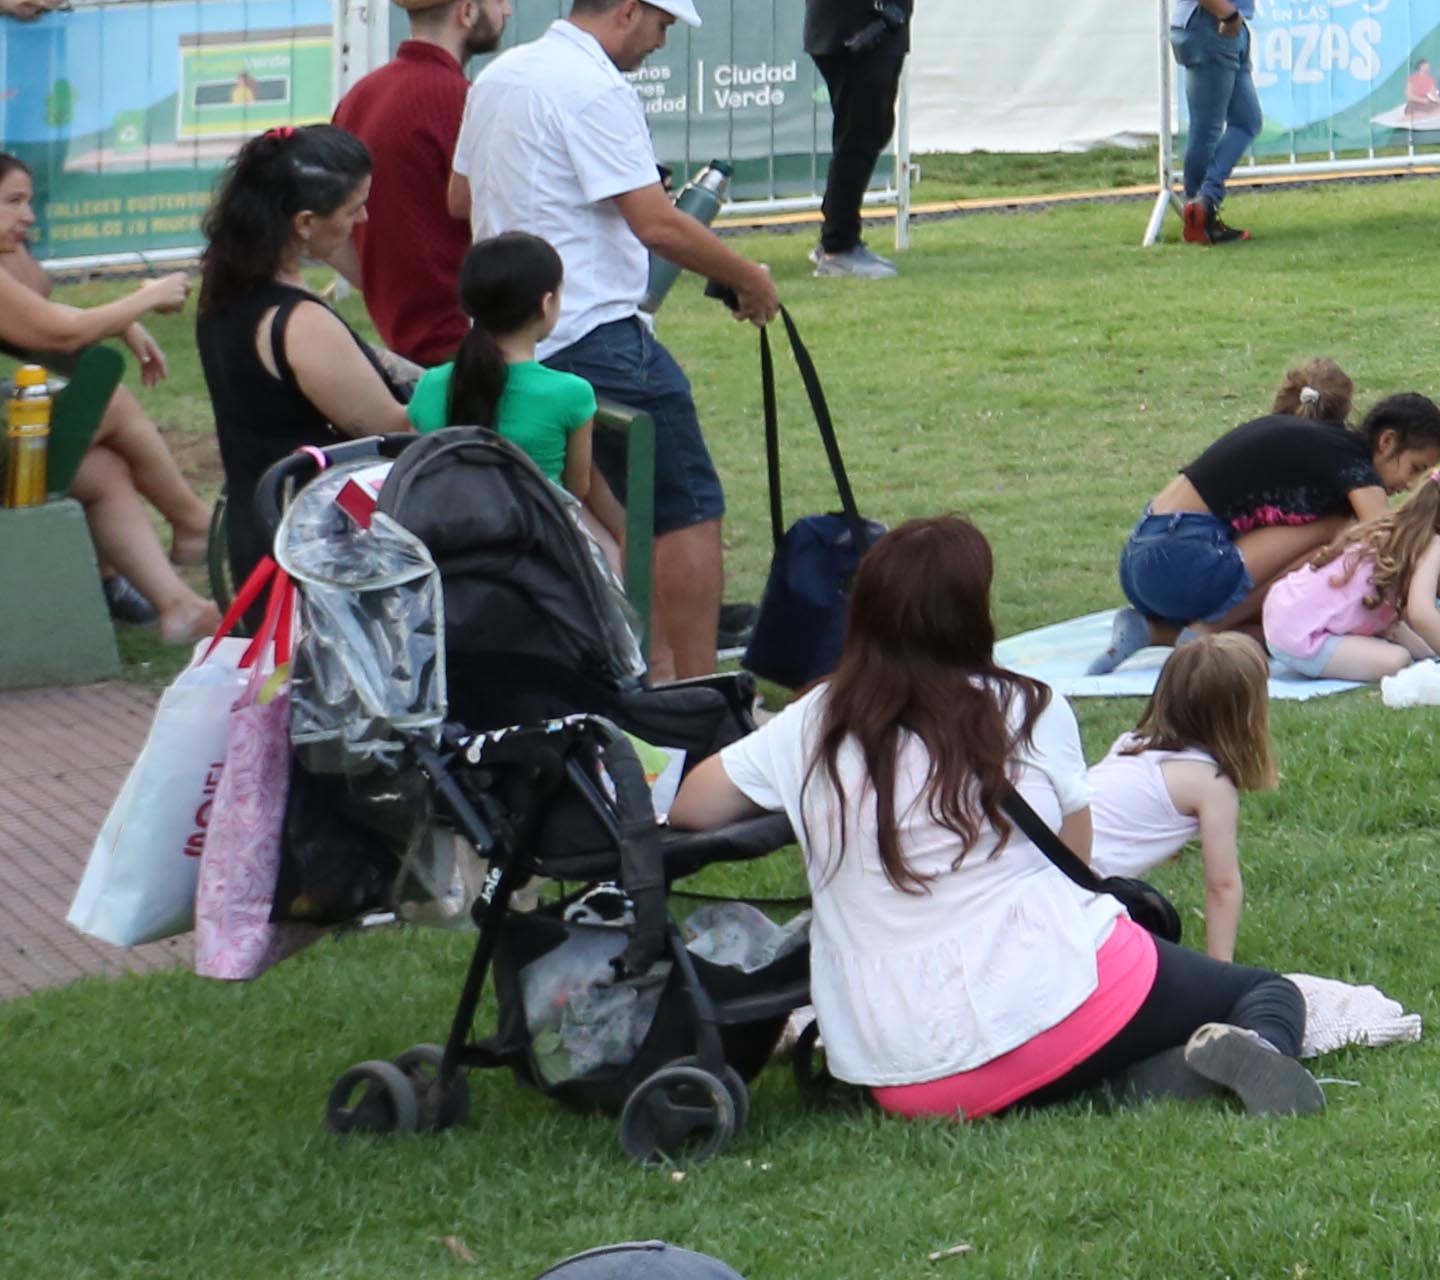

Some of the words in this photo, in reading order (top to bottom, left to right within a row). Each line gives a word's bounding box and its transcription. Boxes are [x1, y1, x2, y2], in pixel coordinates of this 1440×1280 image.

[1297, 2, 1330, 21] LAS
[1250, 17, 1383, 89] LAZAS
[714, 60, 797, 86] Ciudad
[714, 87, 785, 109] Verde
[480, 867, 503, 905] Joie
